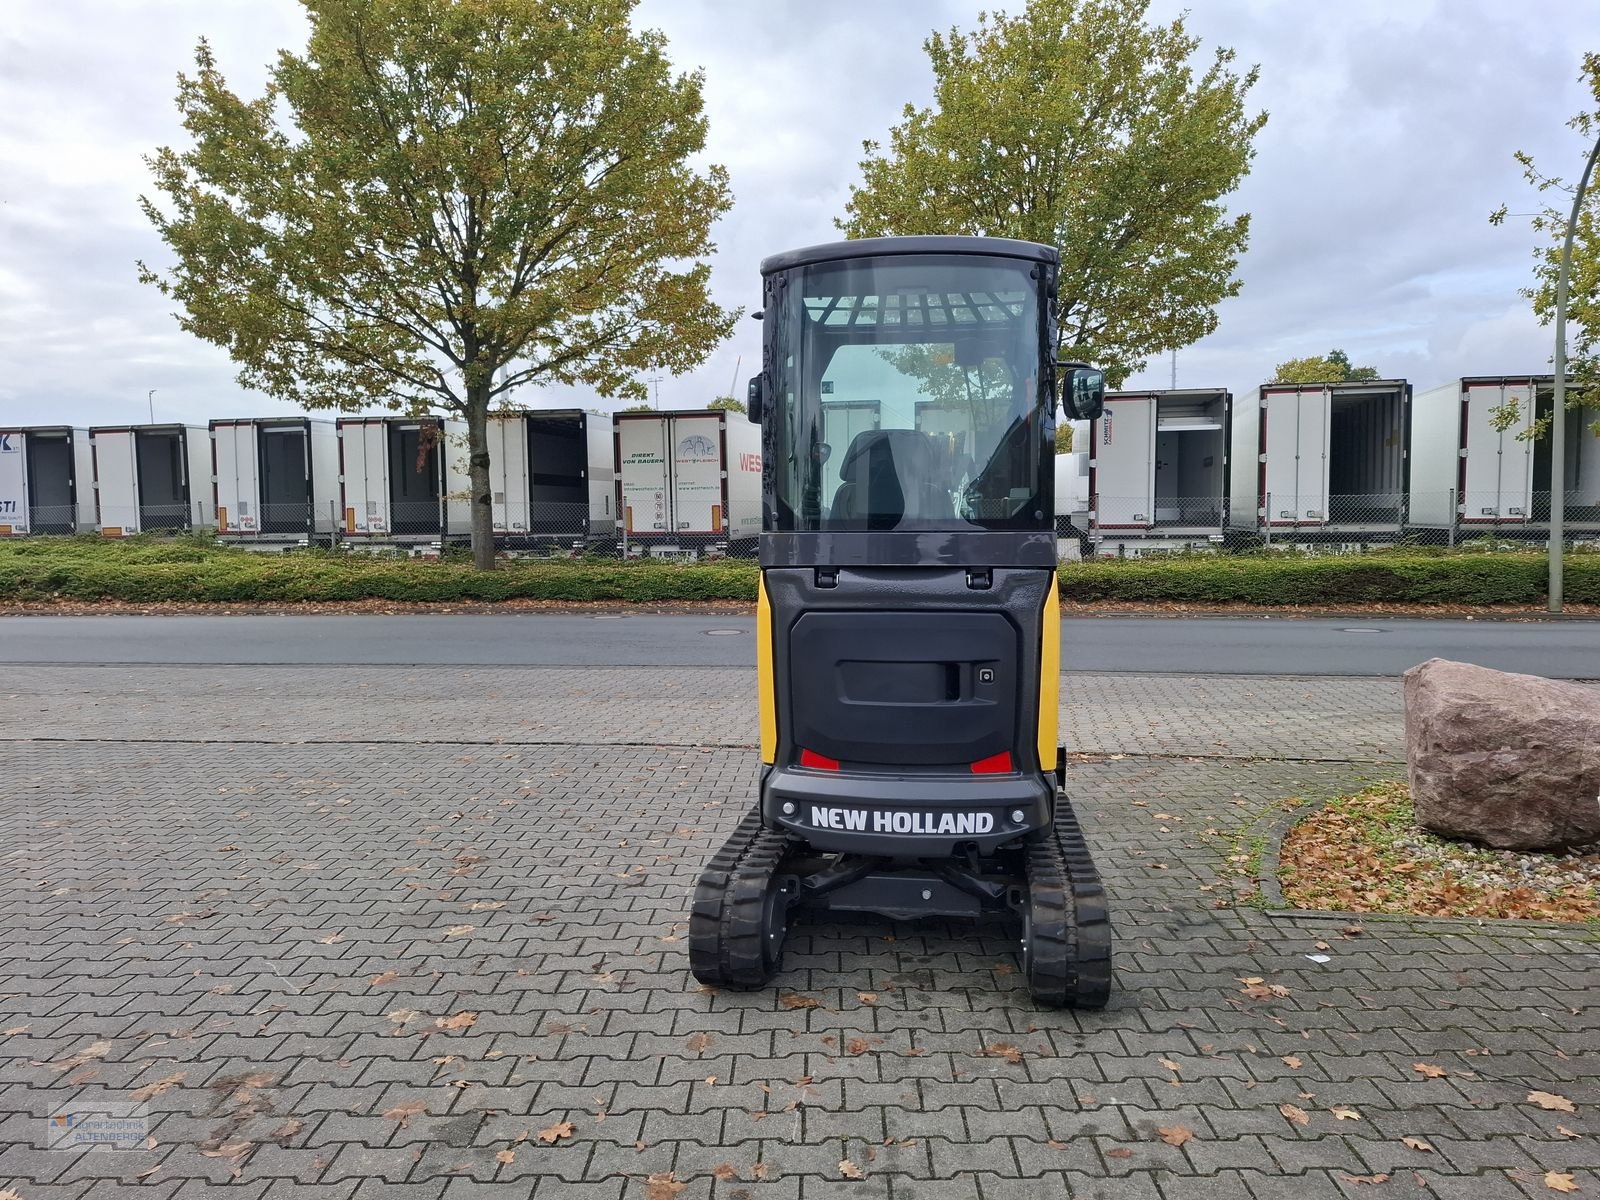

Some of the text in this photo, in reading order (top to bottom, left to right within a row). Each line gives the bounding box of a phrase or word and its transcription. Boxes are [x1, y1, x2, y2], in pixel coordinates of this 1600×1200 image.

[739, 452, 762, 473] WES
[0, 500, 16, 513] TI
[811, 806, 994, 834] NEW HOLLAND
